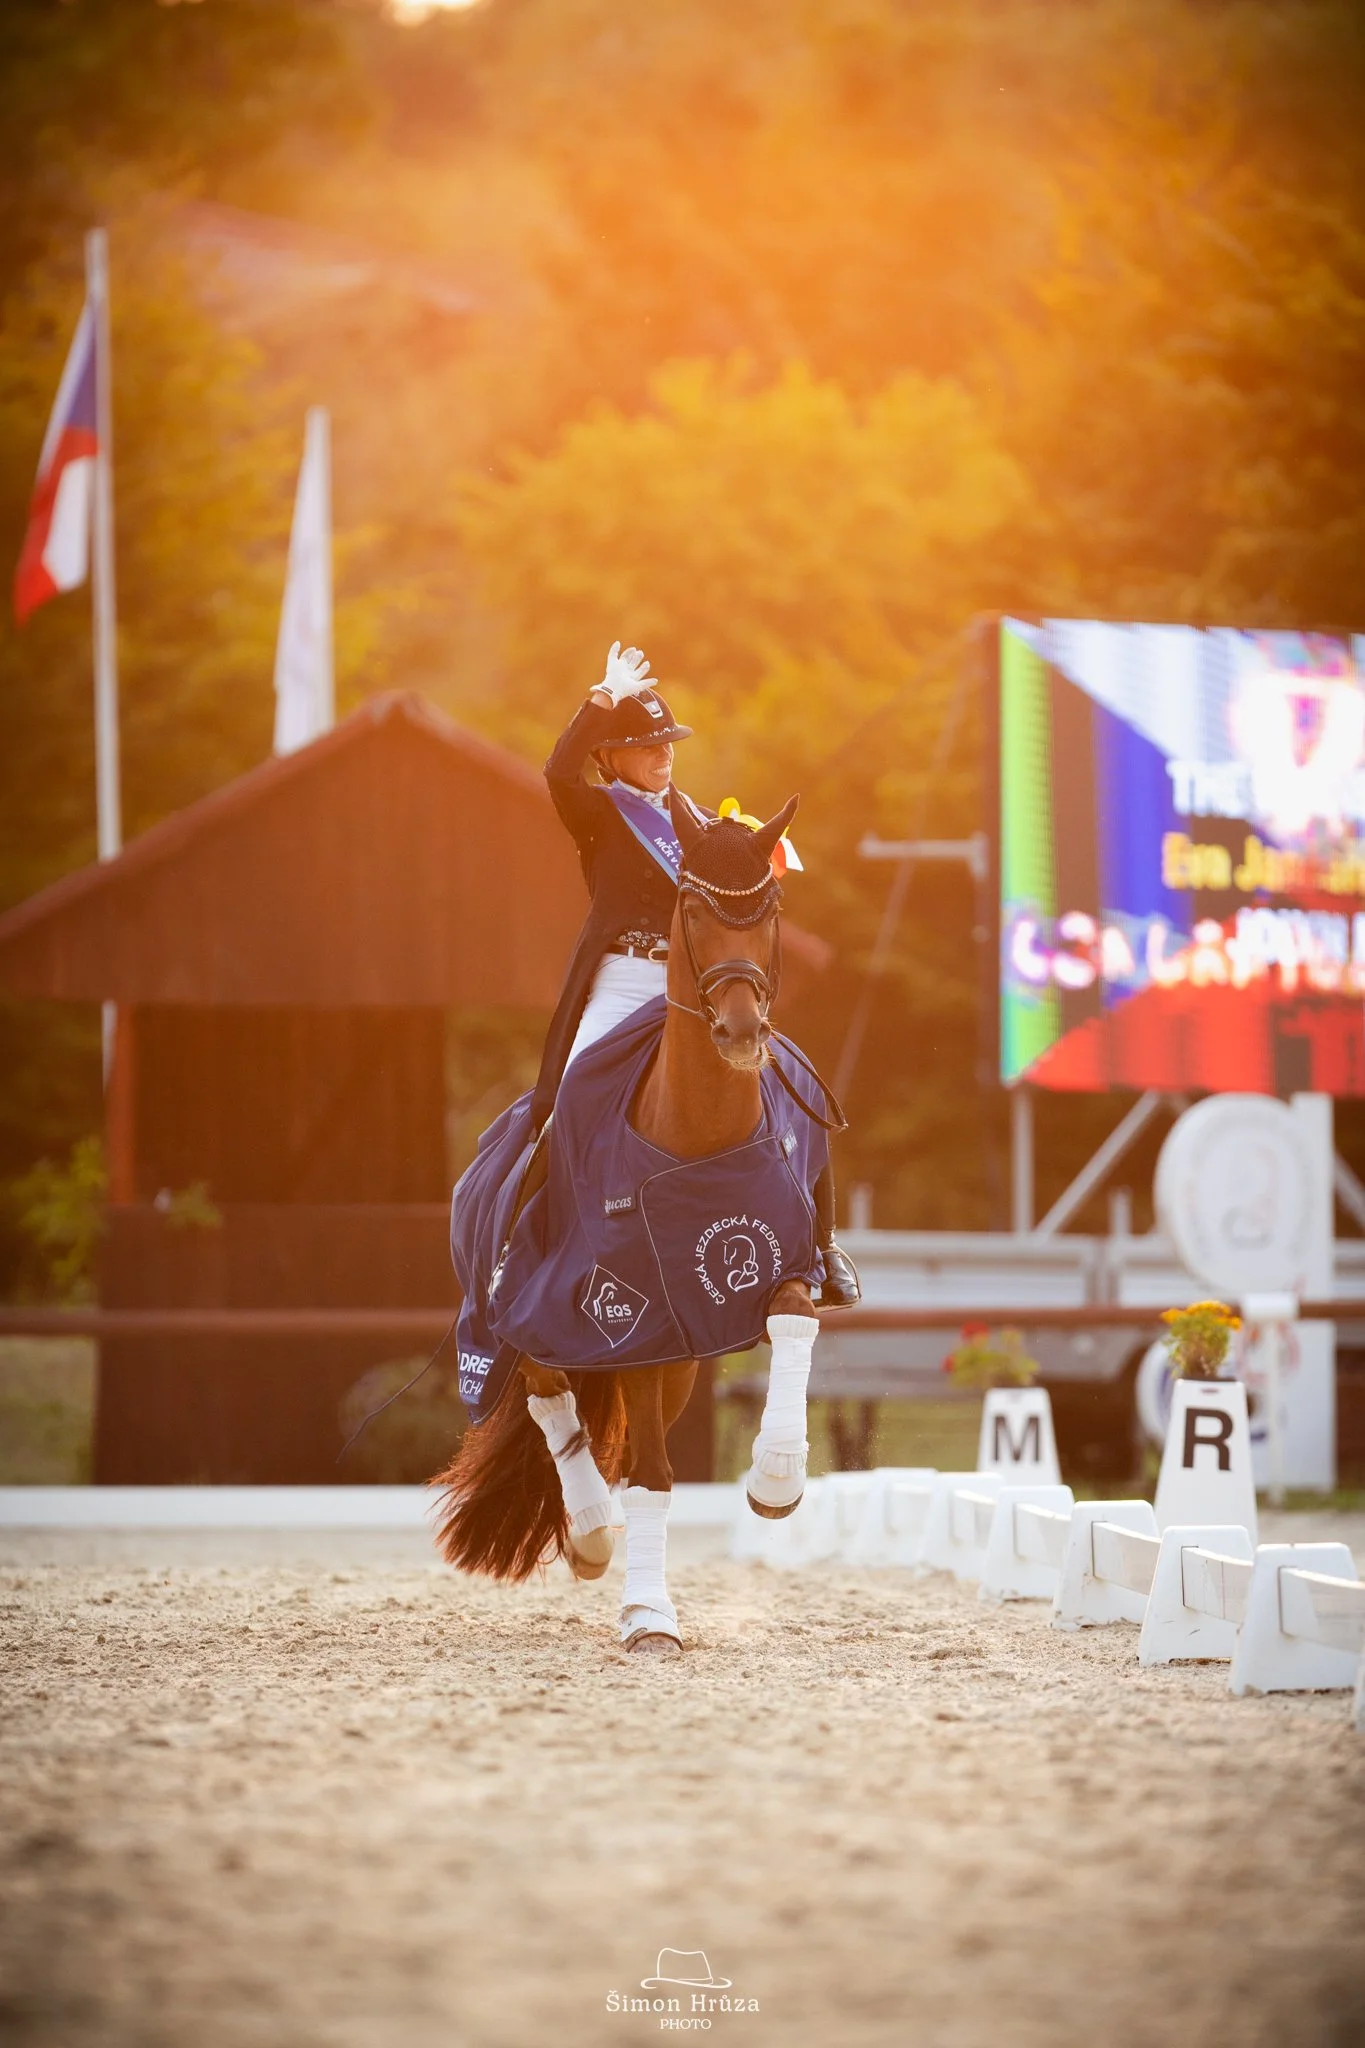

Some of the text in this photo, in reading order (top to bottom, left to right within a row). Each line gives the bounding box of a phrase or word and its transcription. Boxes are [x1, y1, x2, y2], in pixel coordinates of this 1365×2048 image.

[695, 1214, 748, 1260] JEZDECKÁ
[694, 1263, 726, 1305] ČESKÁ
[605, 1303, 632, 1318] EQS
[993, 1415, 1040, 1463] M
[1182, 1405, 1234, 1471] R
